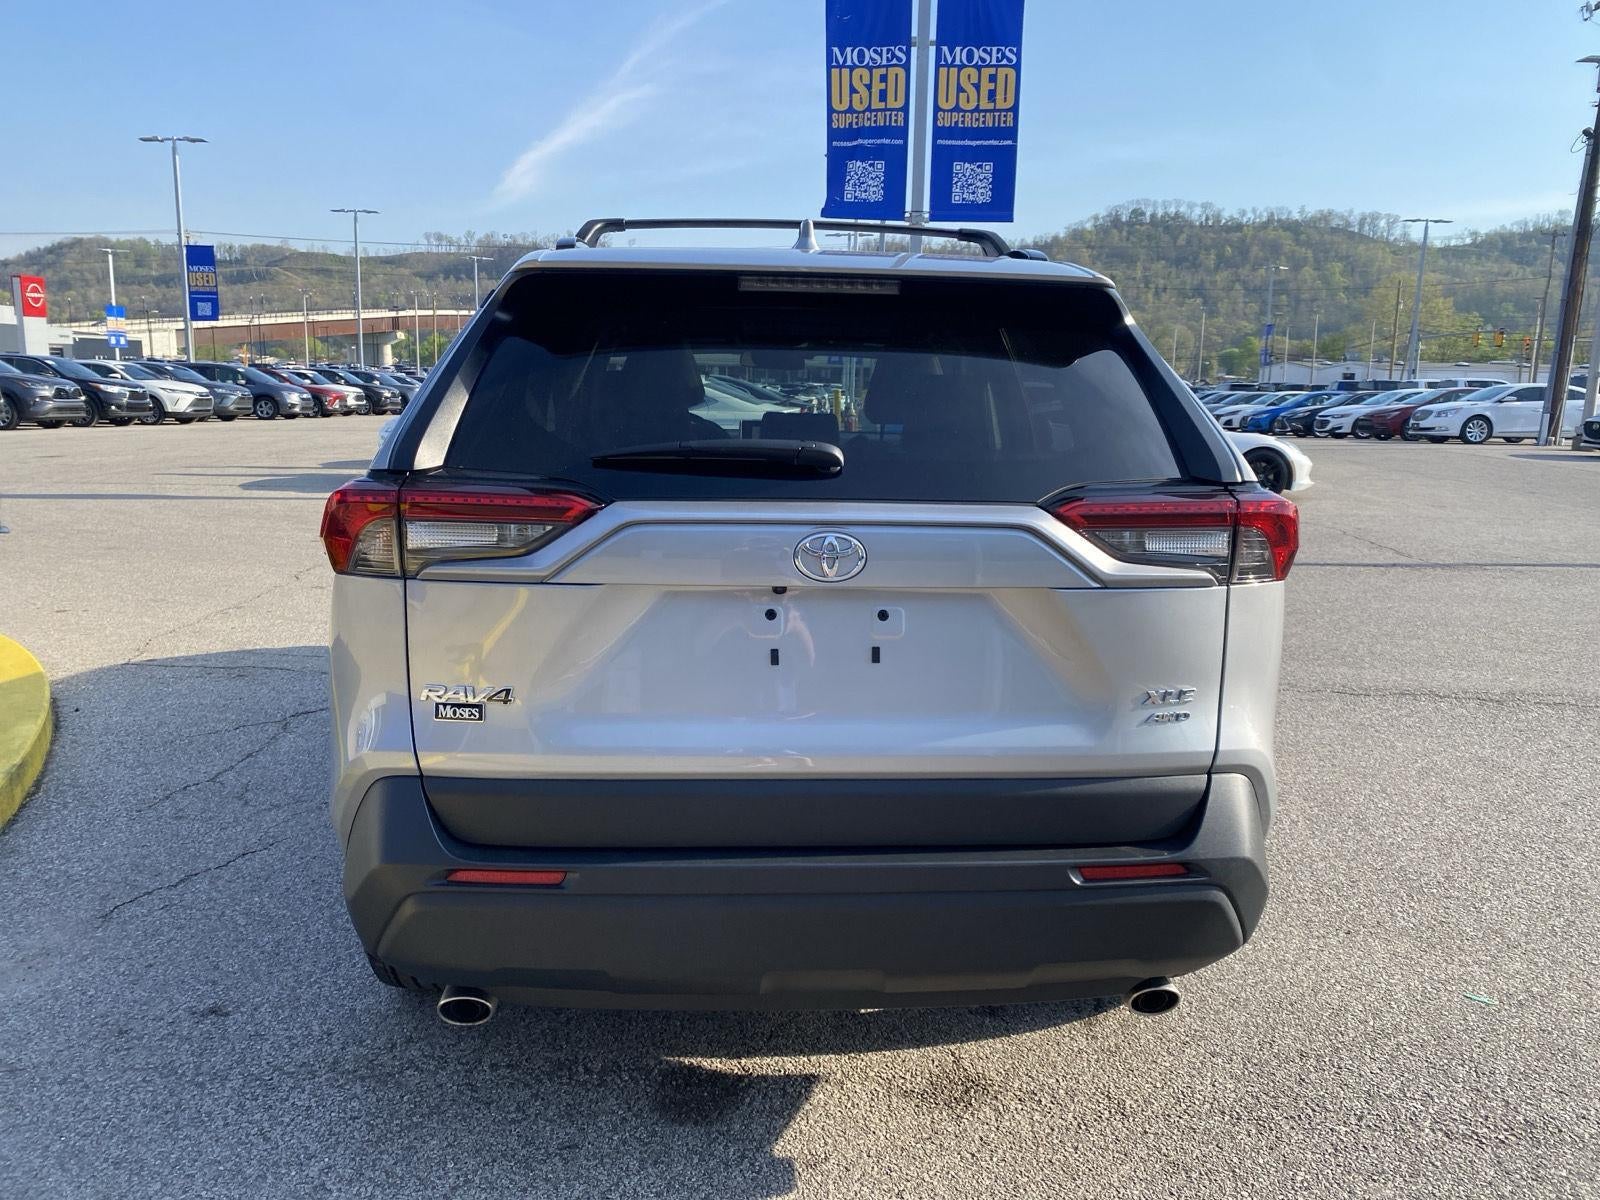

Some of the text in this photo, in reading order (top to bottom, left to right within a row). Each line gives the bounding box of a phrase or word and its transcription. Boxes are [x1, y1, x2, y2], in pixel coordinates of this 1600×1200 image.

[831, 46, 907, 66] MOSES
[940, 46, 1017, 66] MOSES
[831, 67, 906, 111] USED
[937, 67, 1016, 110] USED
[832, 111, 904, 129] SUPERCENTER
[937, 112, 1013, 128] SUPERCENTER
[188, 272, 216, 287] USED
[420, 683, 515, 704] RAV4
[1142, 687, 1197, 705] XLE
